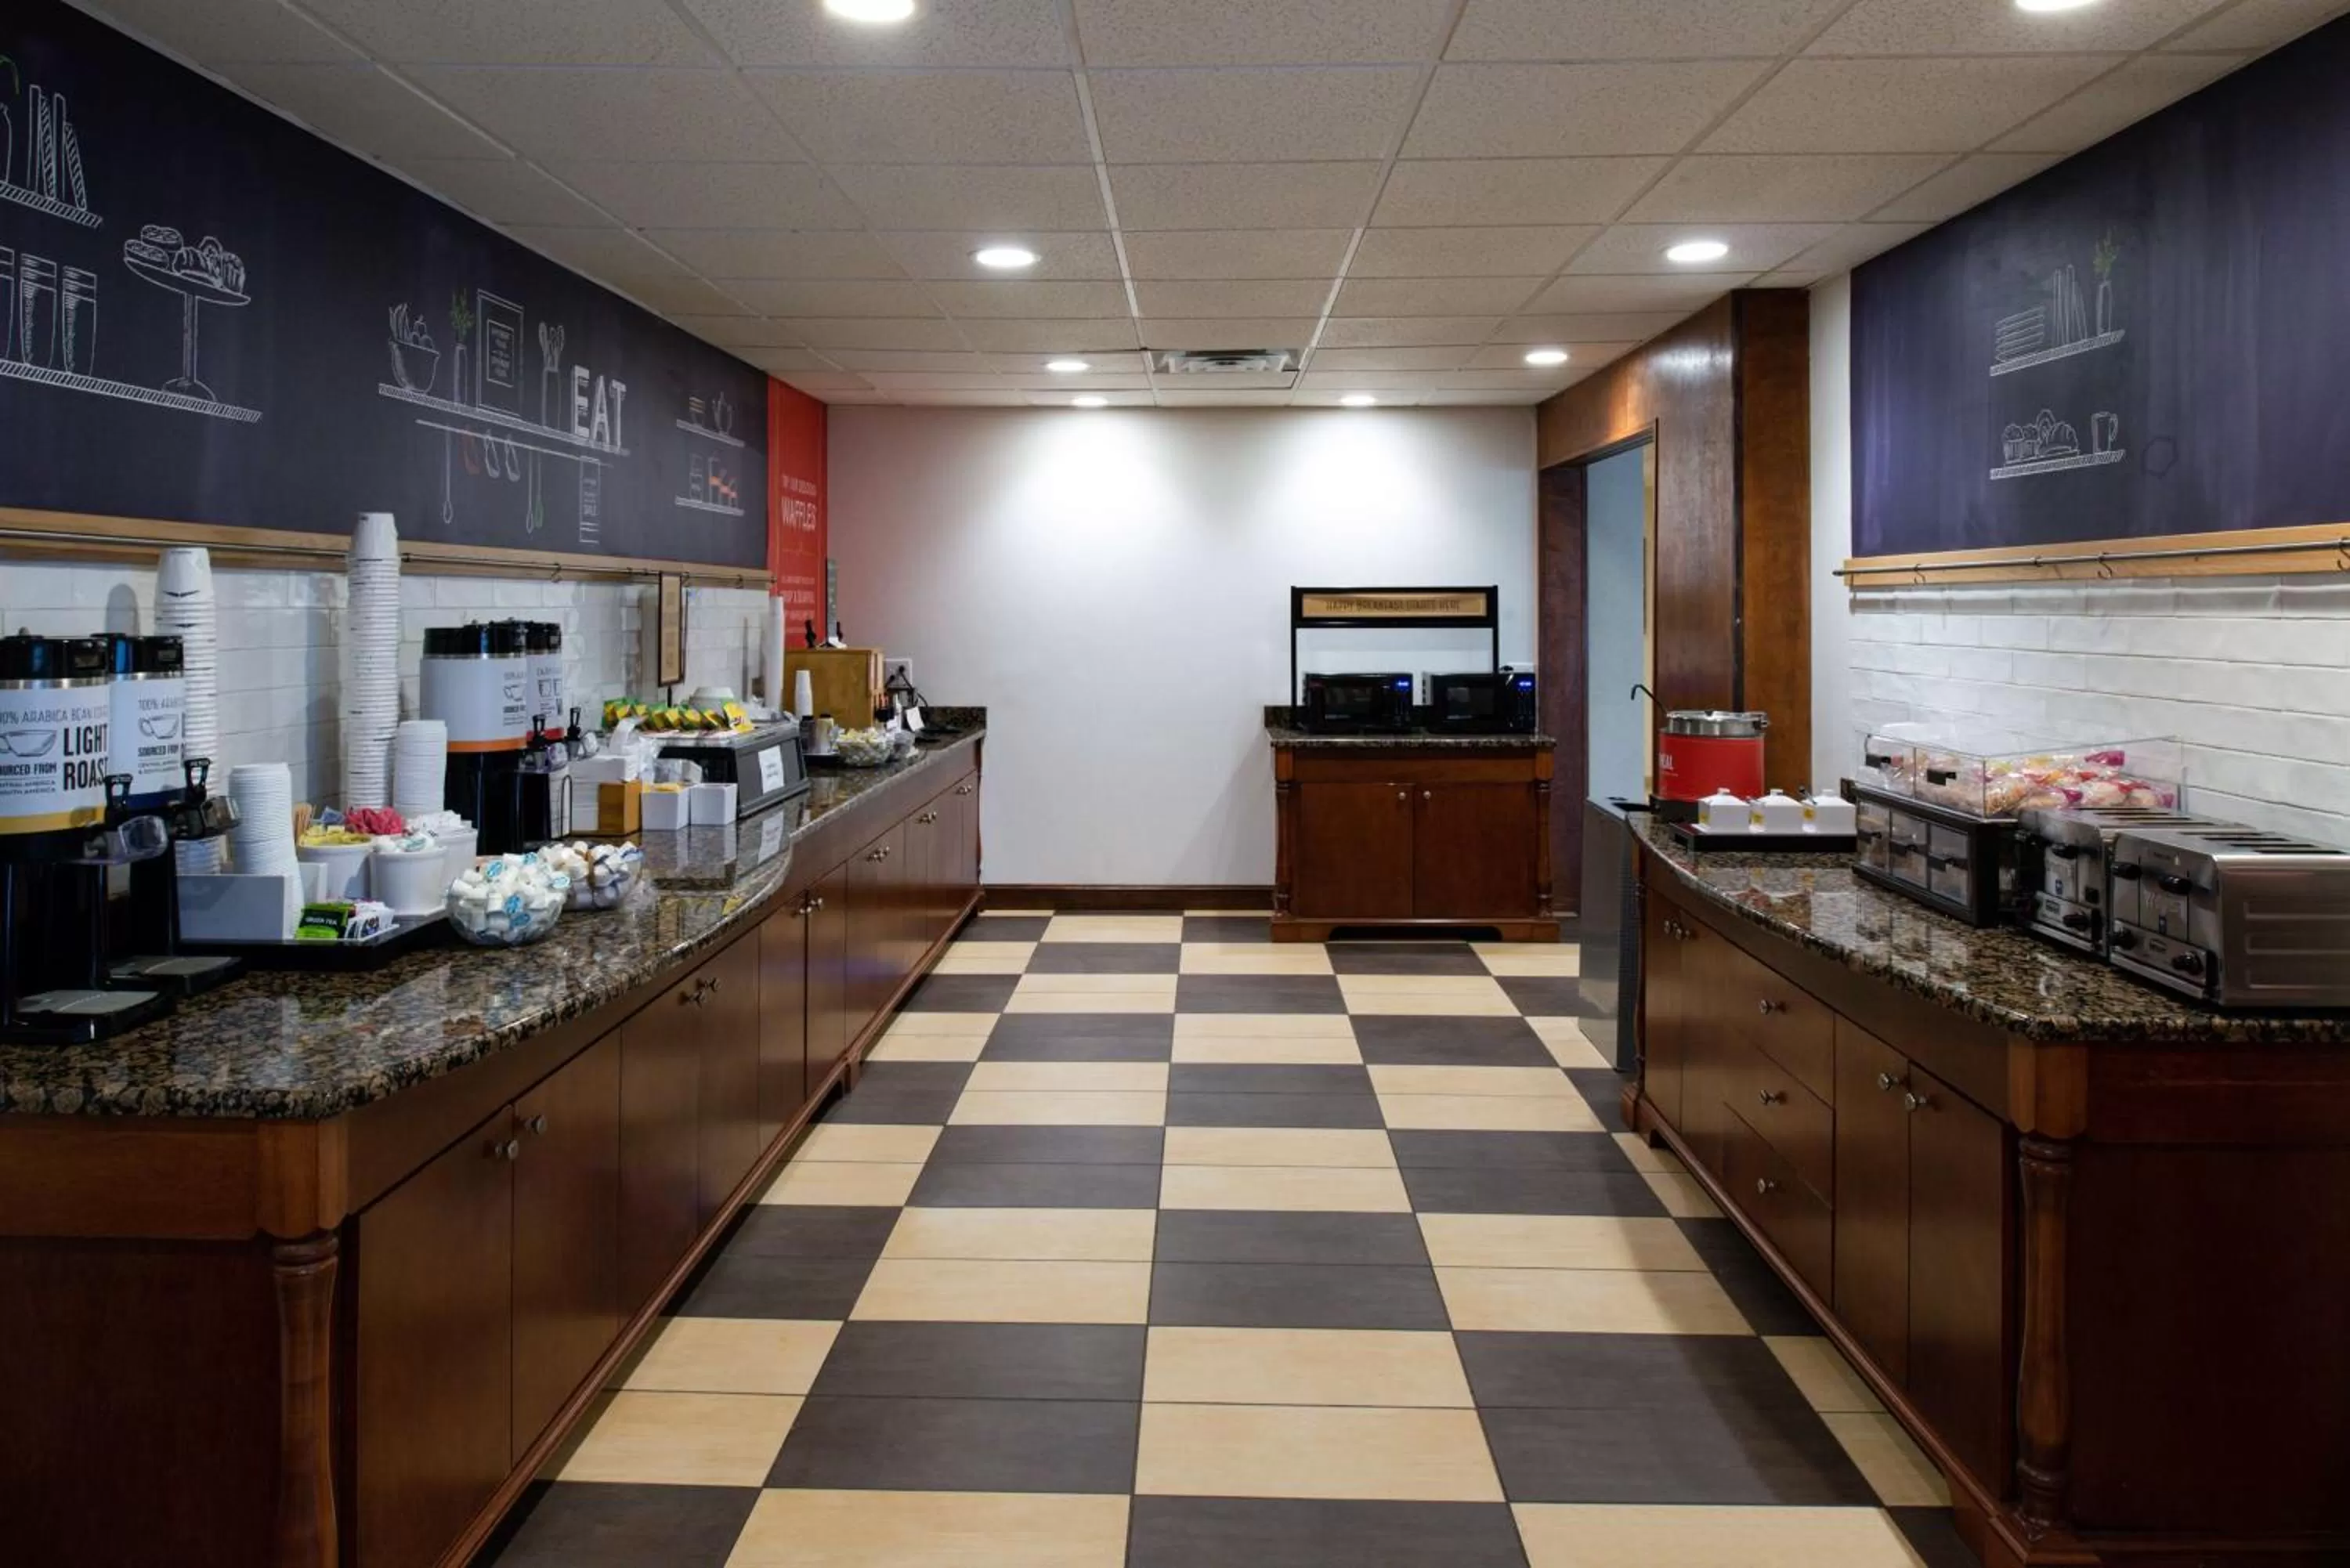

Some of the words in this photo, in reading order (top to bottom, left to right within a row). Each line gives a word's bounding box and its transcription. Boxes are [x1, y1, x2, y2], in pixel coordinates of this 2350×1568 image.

[570, 364, 627, 453] EAT
[782, 496, 817, 531] WAFFLES
[22, 708, 68, 722] ARABICA
[63, 723, 107, 757] LIGHT
[34, 762, 57, 775] FROM
[63, 757, 109, 791] ROAST
